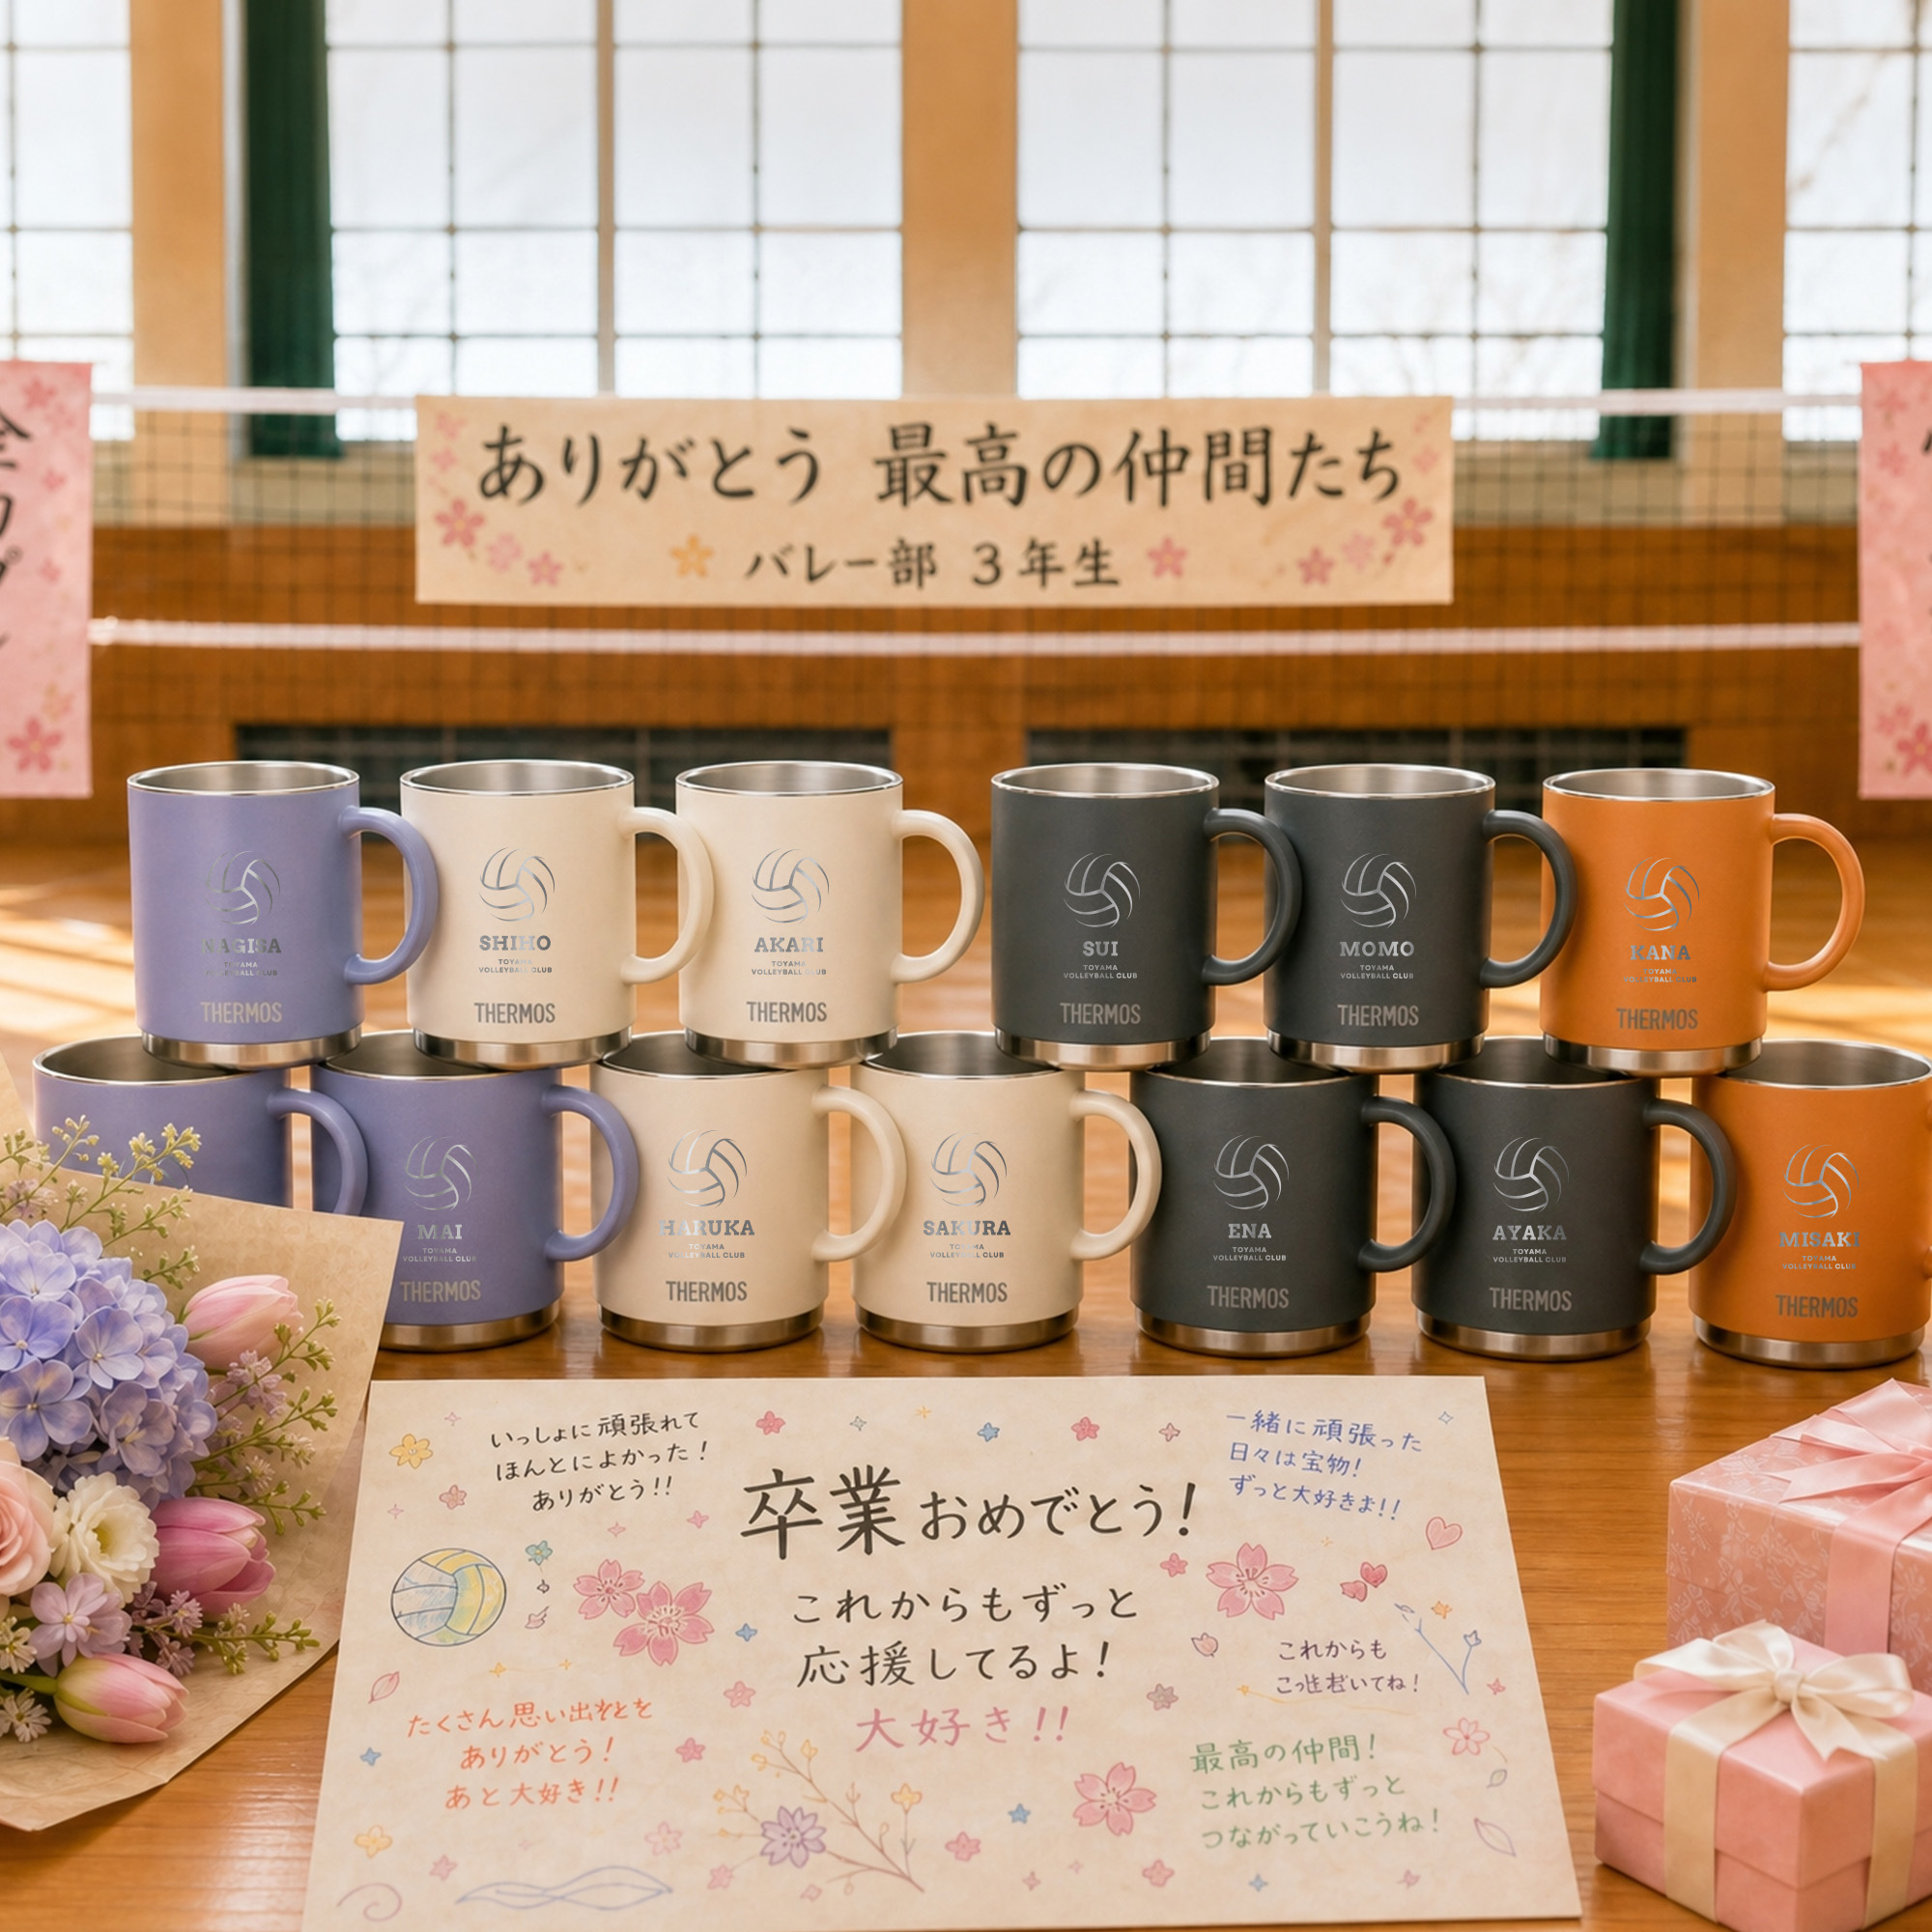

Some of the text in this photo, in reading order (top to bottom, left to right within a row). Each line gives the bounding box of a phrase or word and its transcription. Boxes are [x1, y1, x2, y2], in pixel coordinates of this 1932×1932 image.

[478, 421, 1402, 509] ありがとう 最高の仲間たち
[745, 538, 938, 589] バレー部
[201, 938, 281, 953] NAGISA
[479, 935, 551, 951] SHIHO
[754, 937, 823, 952] AKARI
[1083, 941, 1118, 956] SUI
[1340, 941, 1414, 956] MOMO
[1631, 945, 1690, 960] KANA
[200, 1002, 282, 1023] THERMOS
[473, 1003, 555, 1024] THERMOS
[746, 1002, 827, 1023] THERMOS
[1060, 1003, 1141, 1025] THERMOS
[1337, 1005, 1419, 1026] THERMOS
[1616, 1009, 1698, 1030] THERMOS
[417, 1224, 462, 1239] MAI
[658, 1220, 754, 1236] HARUKA
[923, 1220, 1010, 1236] SAKURA
[1229, 1224, 1271, 1238] ENA
[1492, 1225, 1567, 1240] AYAKA
[1778, 1232, 1860, 1247] MISAKI
[400, 1280, 481, 1302] THERMOS
[666, 1281, 748, 1302] THERMOS
[926, 1282, 1008, 1303] THERMOS
[1207, 1285, 1289, 1309] THERMOS
[1489, 1287, 1572, 1311] THERMOS
[1775, 1294, 1859, 1318] THERMOS
[491, 1411, 699, 1448] いっしょに頑張れて
[1226, 1409, 1422, 1452] 一緒に頑張った
[497, 1440, 708, 1481] ほんとによかった!
[1230, 1442, 1362, 1477] 日々は宝物!
[533, 1475, 672, 1512] ありがとう!!
[793, 1582, 1137, 1624] これからもずっと
[1279, 1639, 1387, 1661] これからも
[797, 1640, 1109, 1688] 応援してるよ!
[460, 1737, 614, 1770] ありがとう!
[1189, 1733, 1376, 1775] 最高の仲間!
[1202, 1775, 1406, 1809] これからもずっと
[1202, 1808, 1438, 1849] つながっていこうね!
